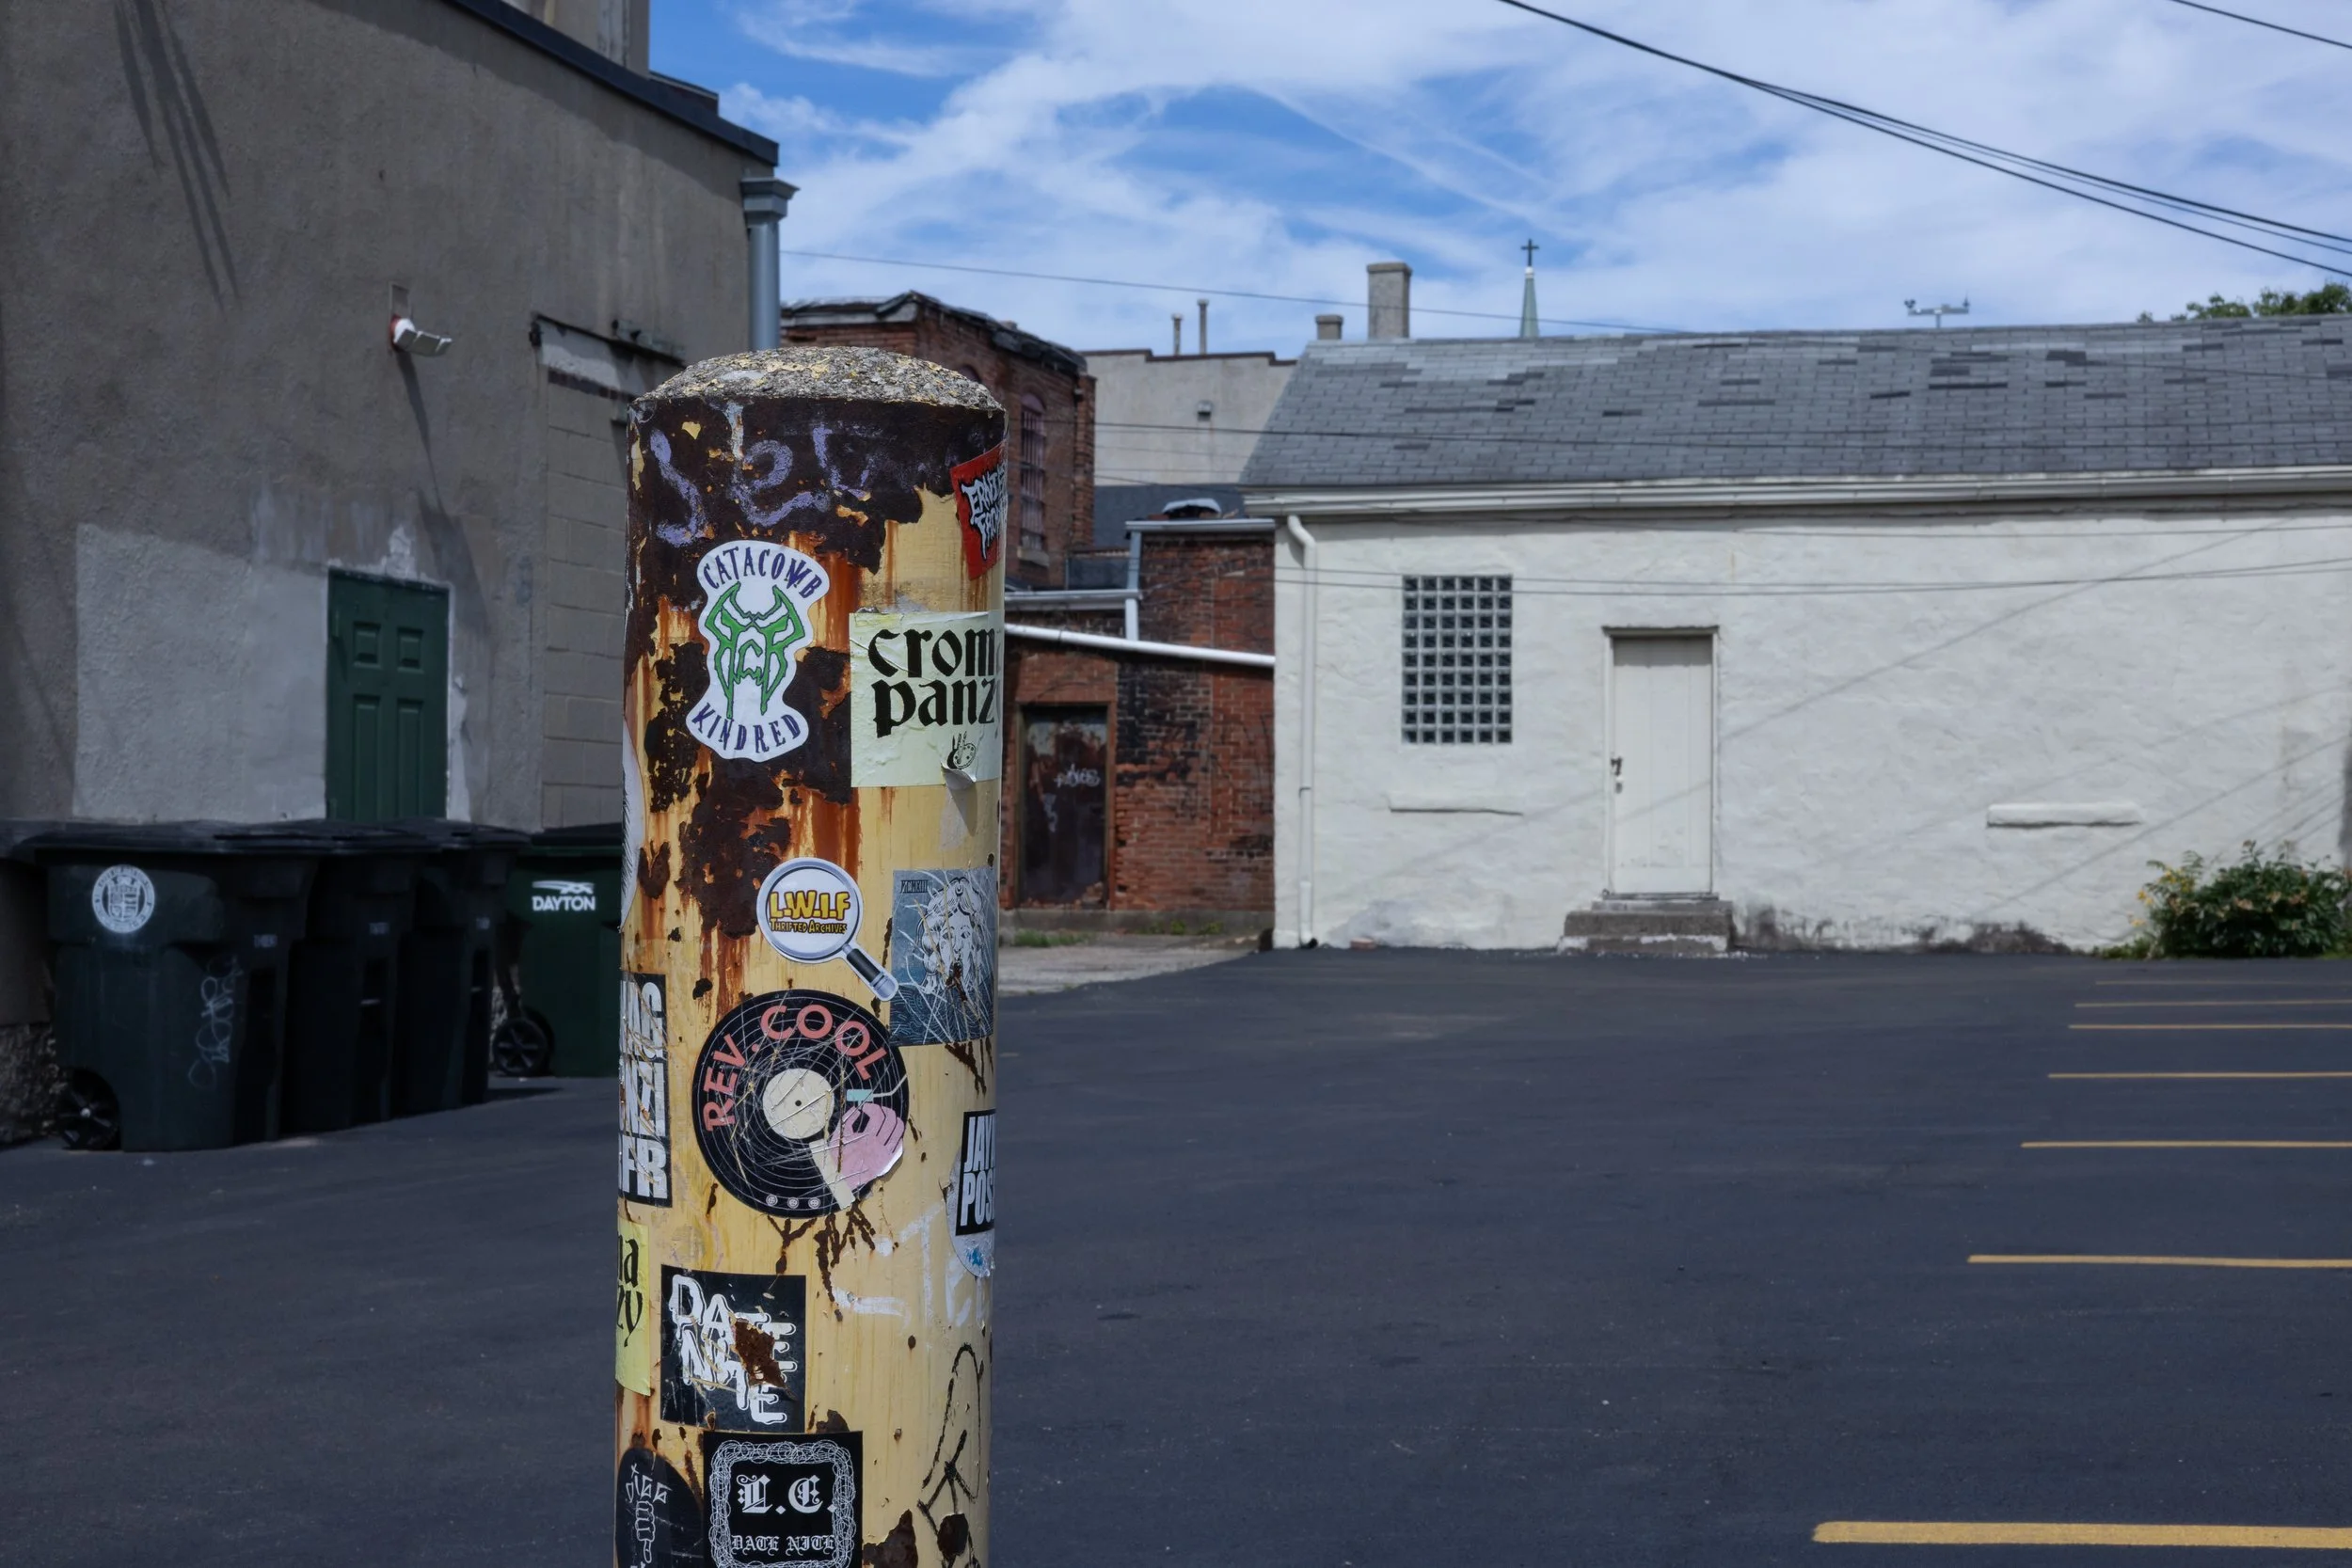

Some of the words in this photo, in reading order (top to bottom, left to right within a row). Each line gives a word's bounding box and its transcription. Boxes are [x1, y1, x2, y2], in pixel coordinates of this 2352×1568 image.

[703, 546, 823, 598] CATACOMB
[691, 703, 802, 753] KINDRED
[532, 895, 596, 911] DAYTON
[703, 1033, 760, 1132] REV.
[759, 1004, 888, 1081] COOL
[731, 1533, 780, 1557] DATE
[785, 1533, 837, 1557] NITE
